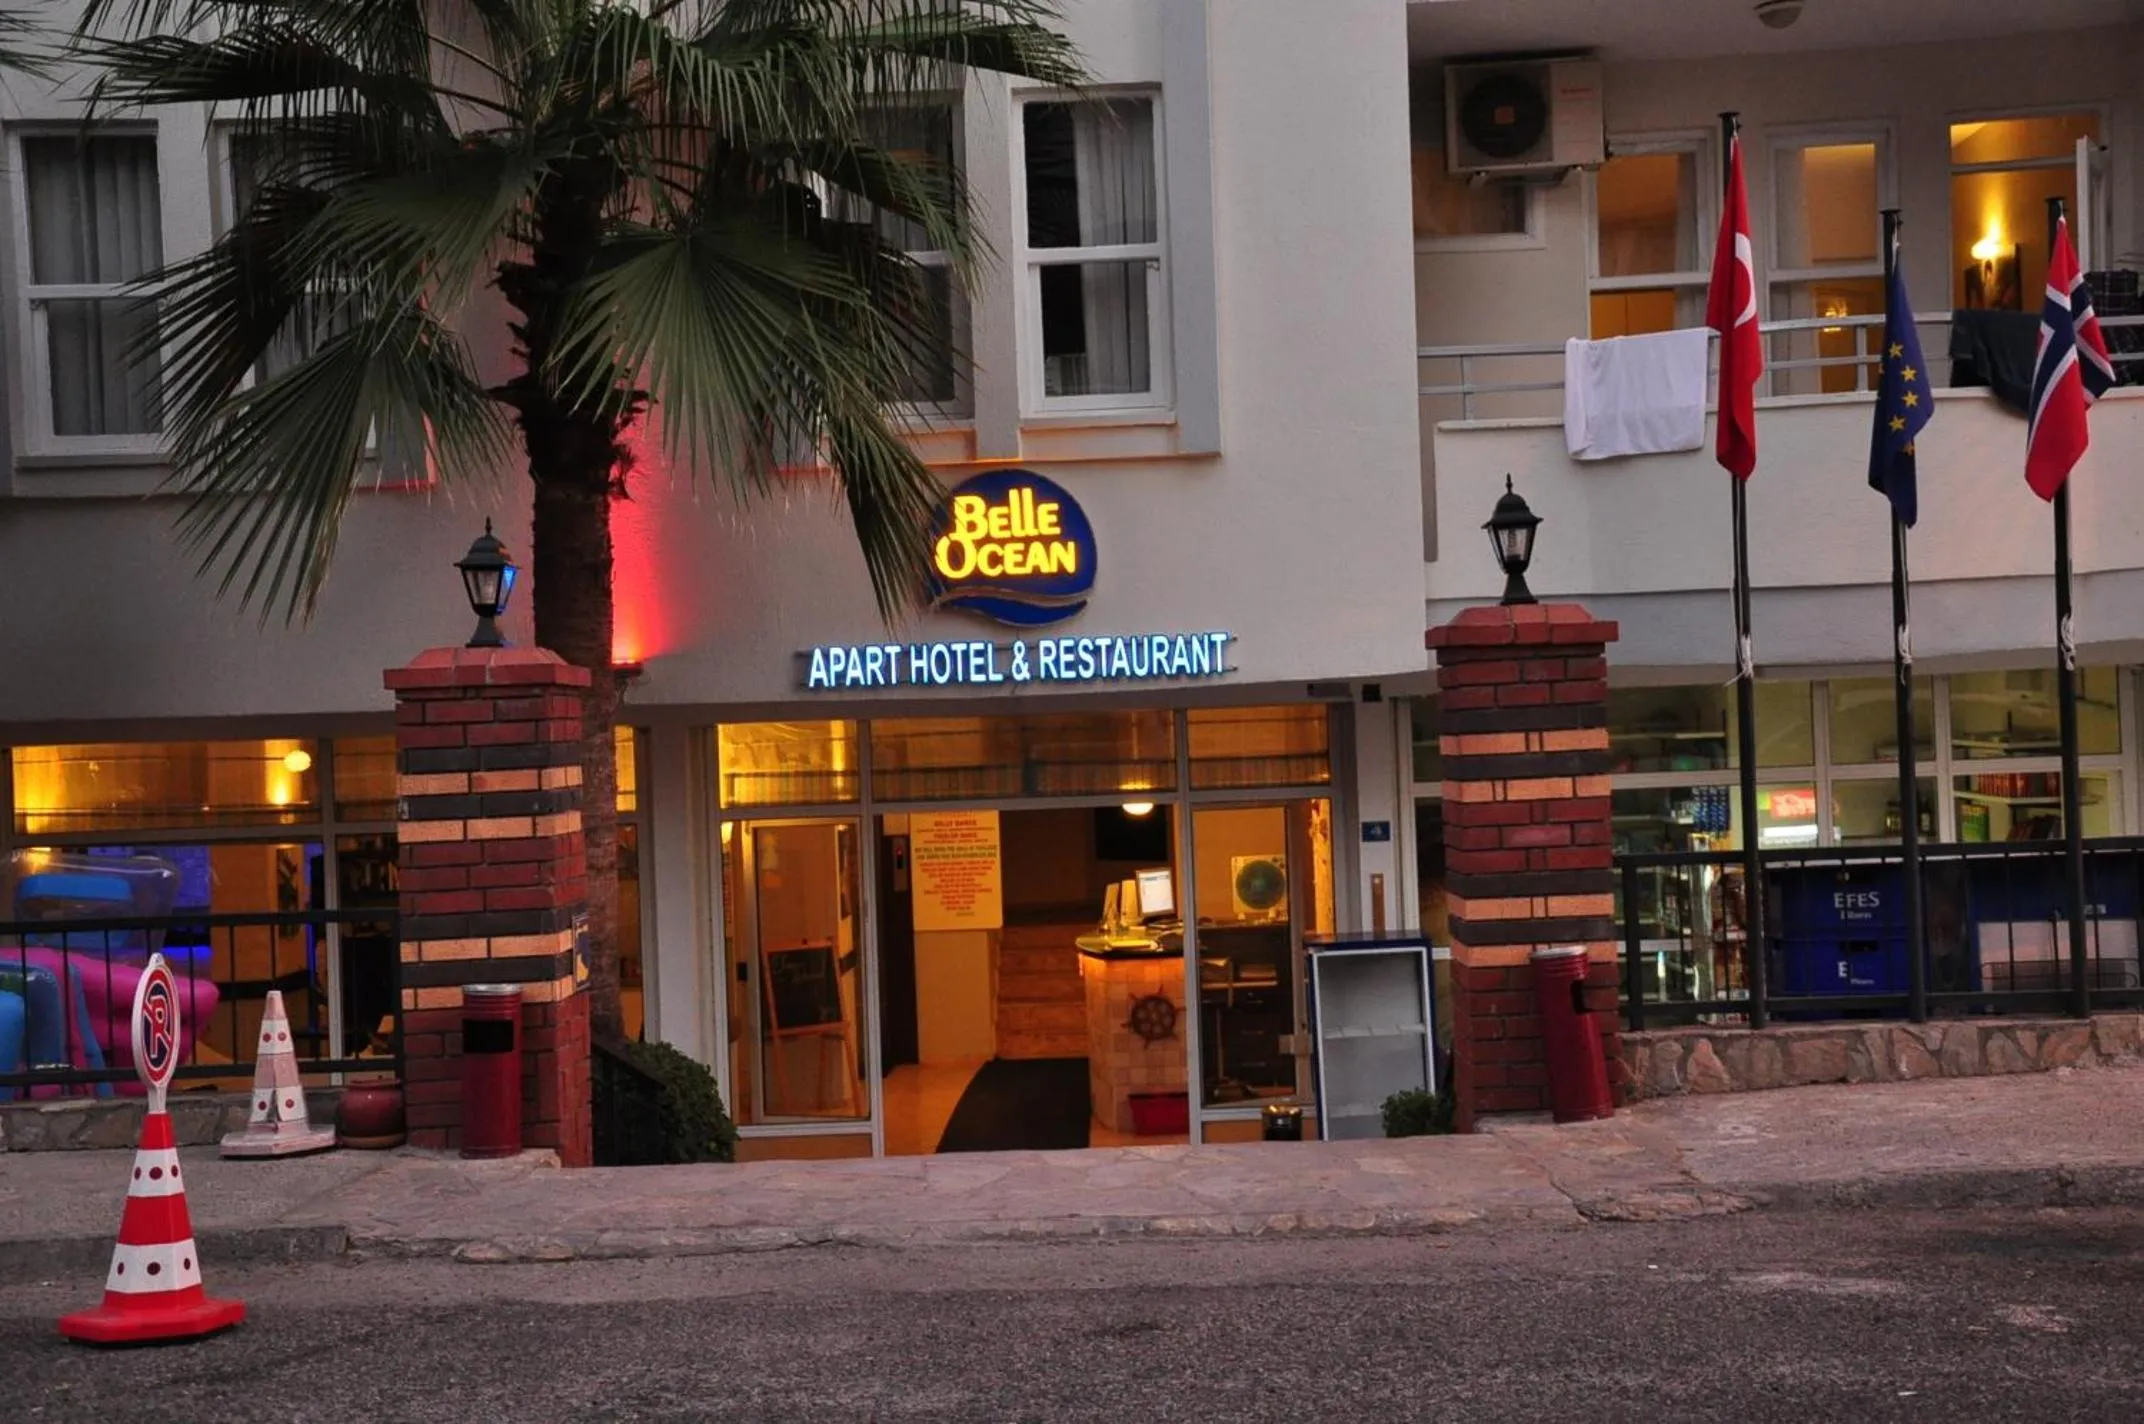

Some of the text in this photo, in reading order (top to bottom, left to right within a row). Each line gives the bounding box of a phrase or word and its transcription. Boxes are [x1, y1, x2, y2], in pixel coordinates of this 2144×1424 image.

[935, 535, 1076, 578] OCEAN
[808, 633, 1227, 687] APART HOTEL & RESTAURANT
[1833, 891, 1880, 909] EFES
